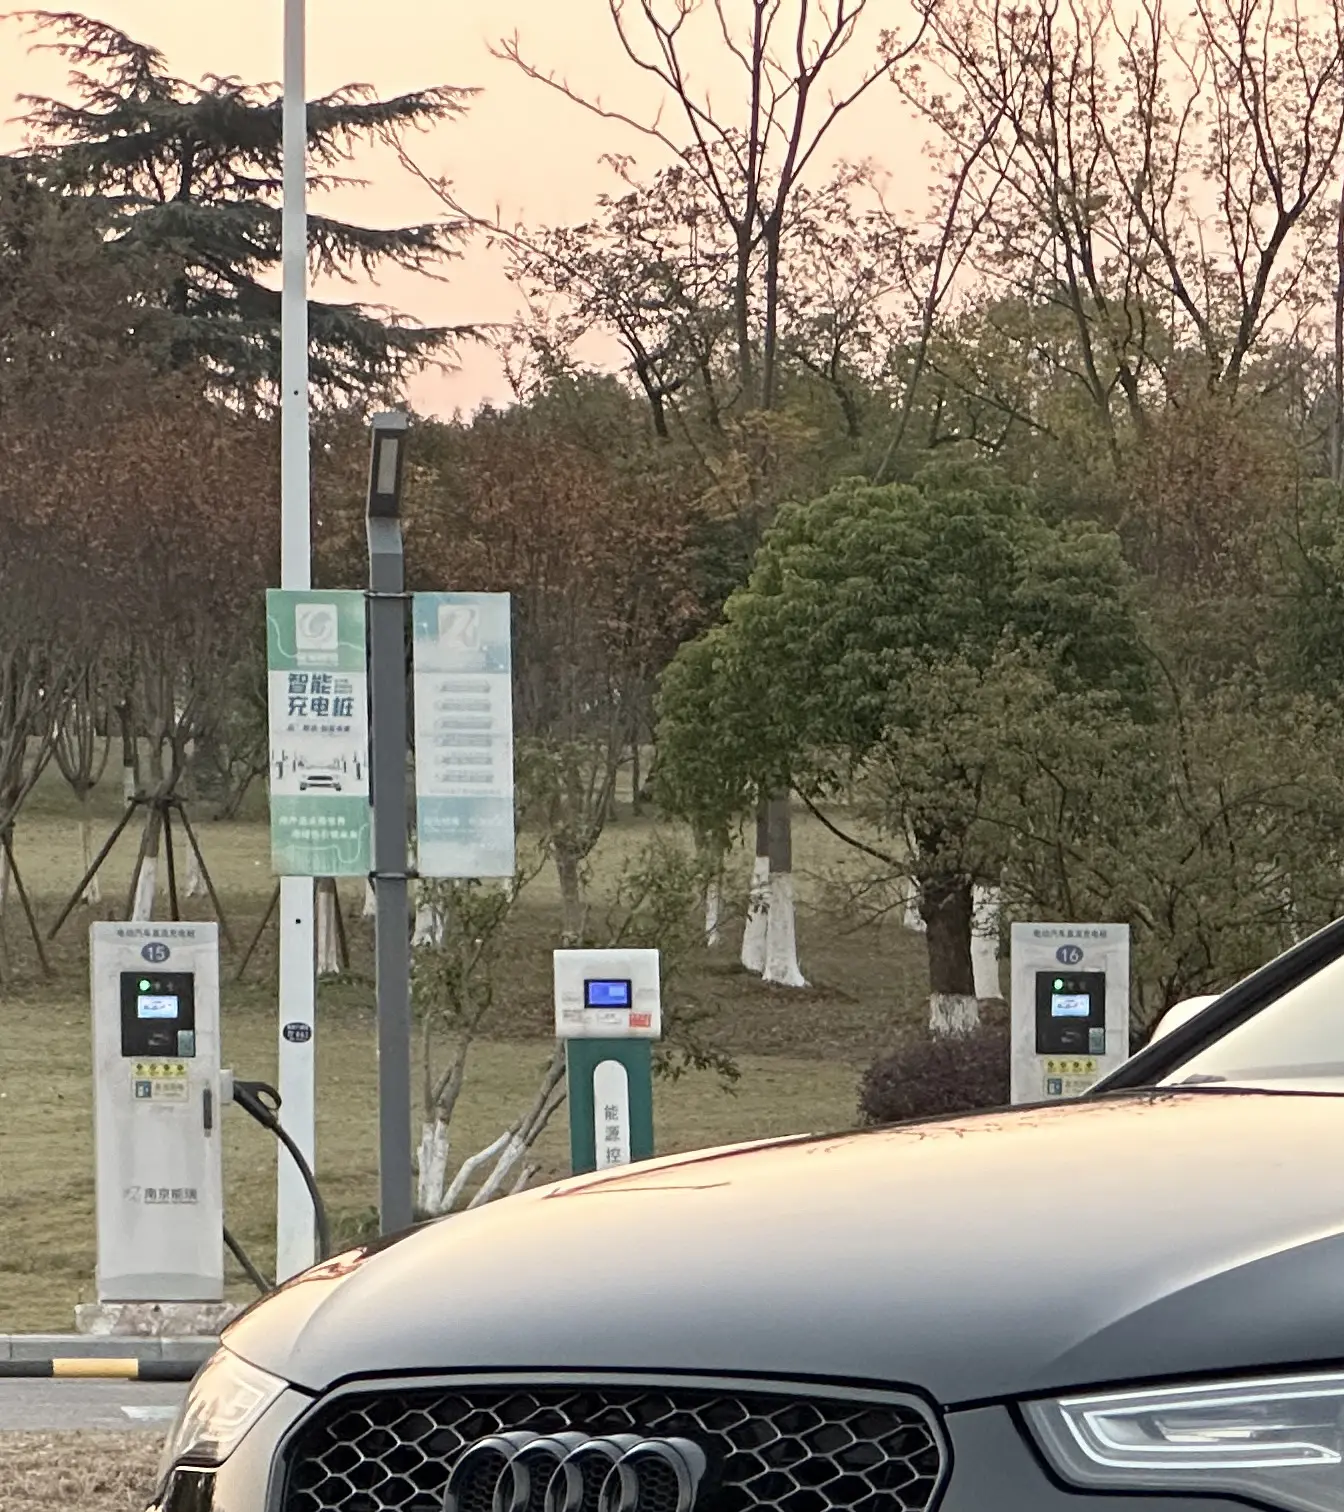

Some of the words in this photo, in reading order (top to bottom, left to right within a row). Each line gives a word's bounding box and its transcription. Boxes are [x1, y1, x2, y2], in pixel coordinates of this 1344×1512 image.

[288, 673, 332, 695] 智能
[288, 696, 354, 717] 充电桩
[148, 946, 166, 961] 15
[1061, 949, 1079, 964] 16
[604, 1104, 622, 1165] 能源控
